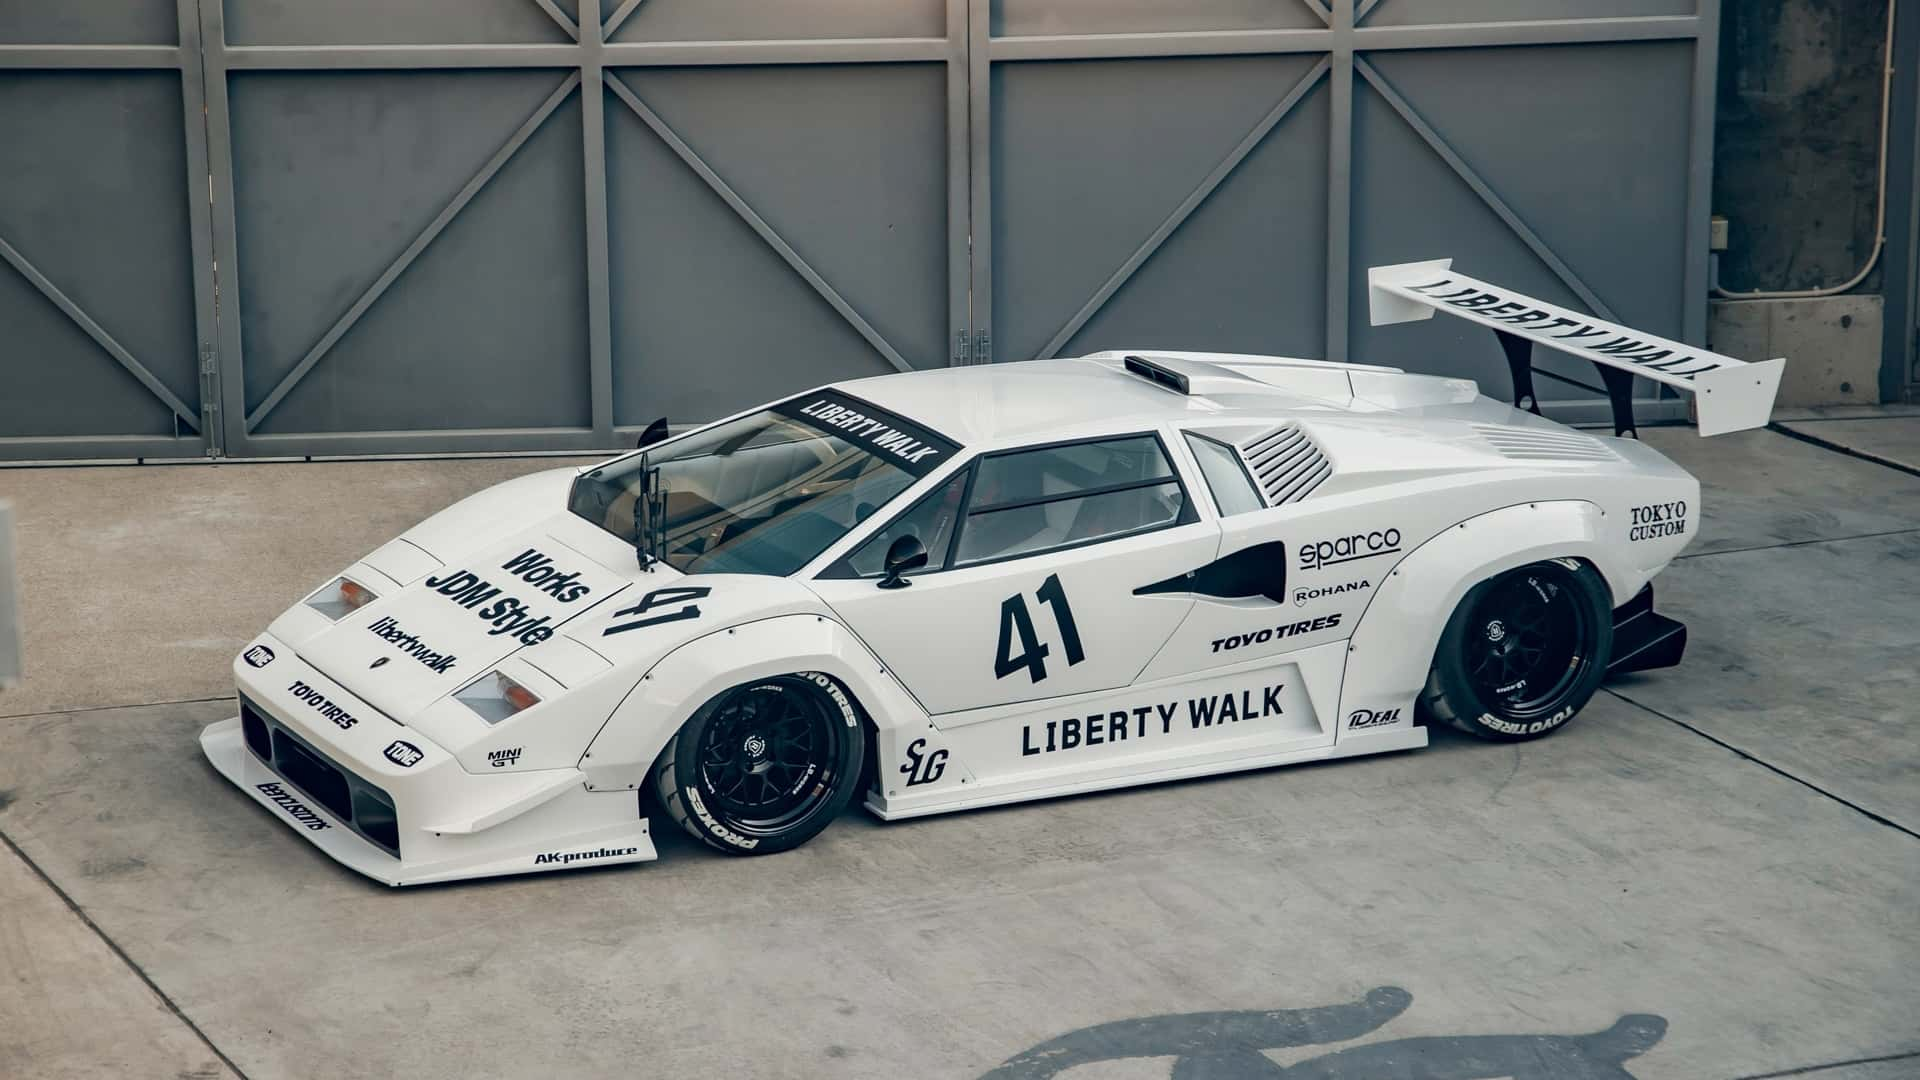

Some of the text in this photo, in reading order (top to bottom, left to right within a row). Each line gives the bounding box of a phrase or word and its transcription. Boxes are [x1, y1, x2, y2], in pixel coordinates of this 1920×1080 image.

[1403, 279, 1609, 339] LIBERTY
[800, 400, 939, 464] LIBERTY WALK
[1630, 520, 1686, 541] CUSTOM
[1631, 501, 1687, 525] TOKYO
[1299, 528, 1401, 570] sparco
[501, 548, 591, 603] Works
[1296, 579, 1371, 602] ROHANA
[425, 569, 554, 646] JDM Style
[602, 587, 712, 637] 41
[994, 572, 1085, 684] 41
[367, 616, 458, 674] libertywalk
[1211, 613, 1342, 653] TOYO TIRES
[245, 645, 273, 668] TONE
[288, 680, 359, 730] TOYO TIRES
[1022, 684, 1285, 757] LIBERTY WALK
[1348, 708, 1401, 728] IDEAL
[1477, 705, 1575, 734] TOYO TIRES
[385, 741, 423, 766] TONE
[487, 747, 522, 761] MINI
[491, 756, 521, 767] GT
[686, 785, 760, 850] PROXES
[534, 847, 638, 864] AK-produce
